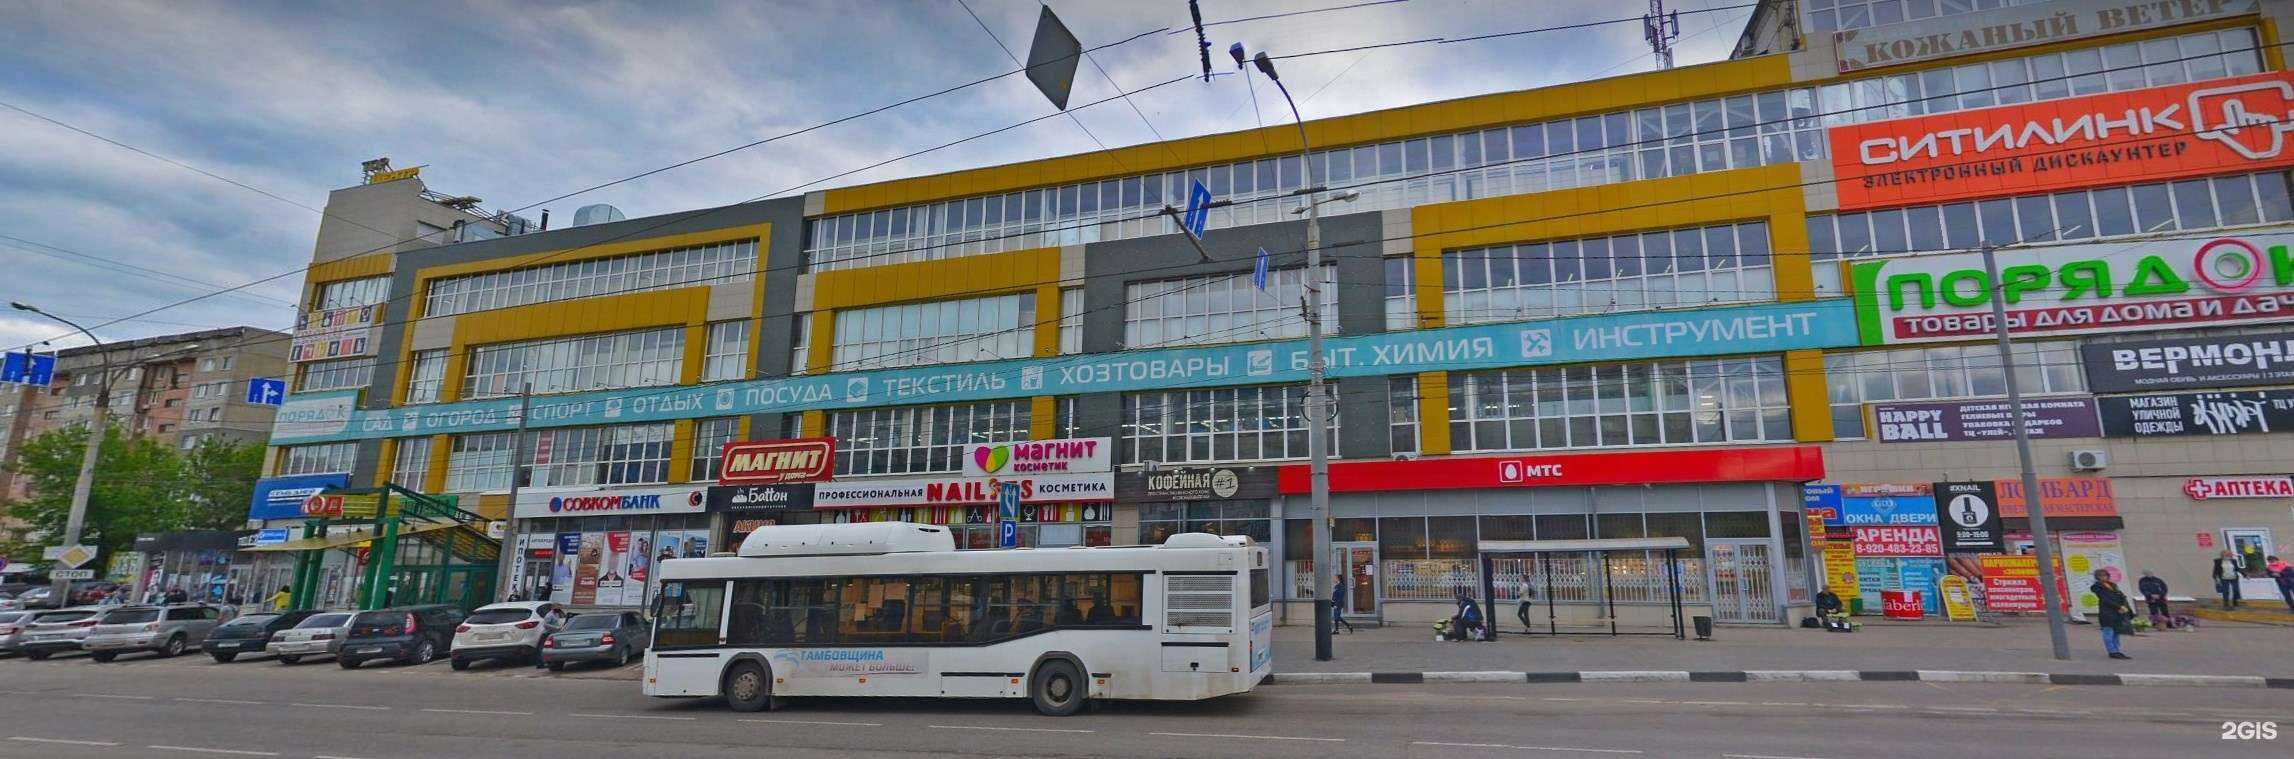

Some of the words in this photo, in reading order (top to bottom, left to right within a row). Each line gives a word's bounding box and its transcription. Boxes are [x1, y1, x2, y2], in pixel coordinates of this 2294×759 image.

[1864, 11, 2080, 63] КОЖАНЫЙ
[1859, 103, 2185, 165] СИТИЛИНК
[1862, 157, 2024, 189] ЭЛЕКТРОННЫЙ
[2032, 141, 2188, 173] ДИСКАУНТЕР
[361, 414, 393, 432] САД
[426, 411, 496, 428] ОГОРОД
[532, 400, 593, 420] СПОРТ
[632, 393, 705, 414] ОТДЫХ
[745, 382, 833, 406] ПОСУДА
[883, 372, 1006, 397] ТЕКСТИЛЬ
[1059, 356, 1231, 385] ХОЗТОВАРЫ
[1372, 336, 1494, 366] ХИМИЯ
[1574, 312, 1818, 350] ИНСТРУМЕНТ
[2129, 396, 2179, 409] МАГАЗИН
[1879, 409, 1943, 423] HAPPY
[2132, 407, 2182, 421] УЛИЧНОЙ
[1881, 422, 1948, 441] BALL
[2134, 420, 2184, 434] ОДЕЖДЫ
[729, 450, 823, 472] МАГНИТ
[1527, 464, 1563, 477] МТС
[1148, 471, 1211, 490] КОФЕЙНАЯ
[2215, 480, 2292, 495] АПТЕКА
[819, 488, 923, 500] ПРОФЕССИОНАЛЬНАЯ
[1039, 482, 1106, 494] КОСМЕТИКА
[563, 494, 662, 512] СОВКОМБАНК
[1846, 513, 1884, 523] ОКНА
[1889, 513, 1937, 525] ДВЕРИ
[1856, 528, 1938, 543] АРЕНДА
[800, 649, 884, 663] ТАМБОВЩИНА
